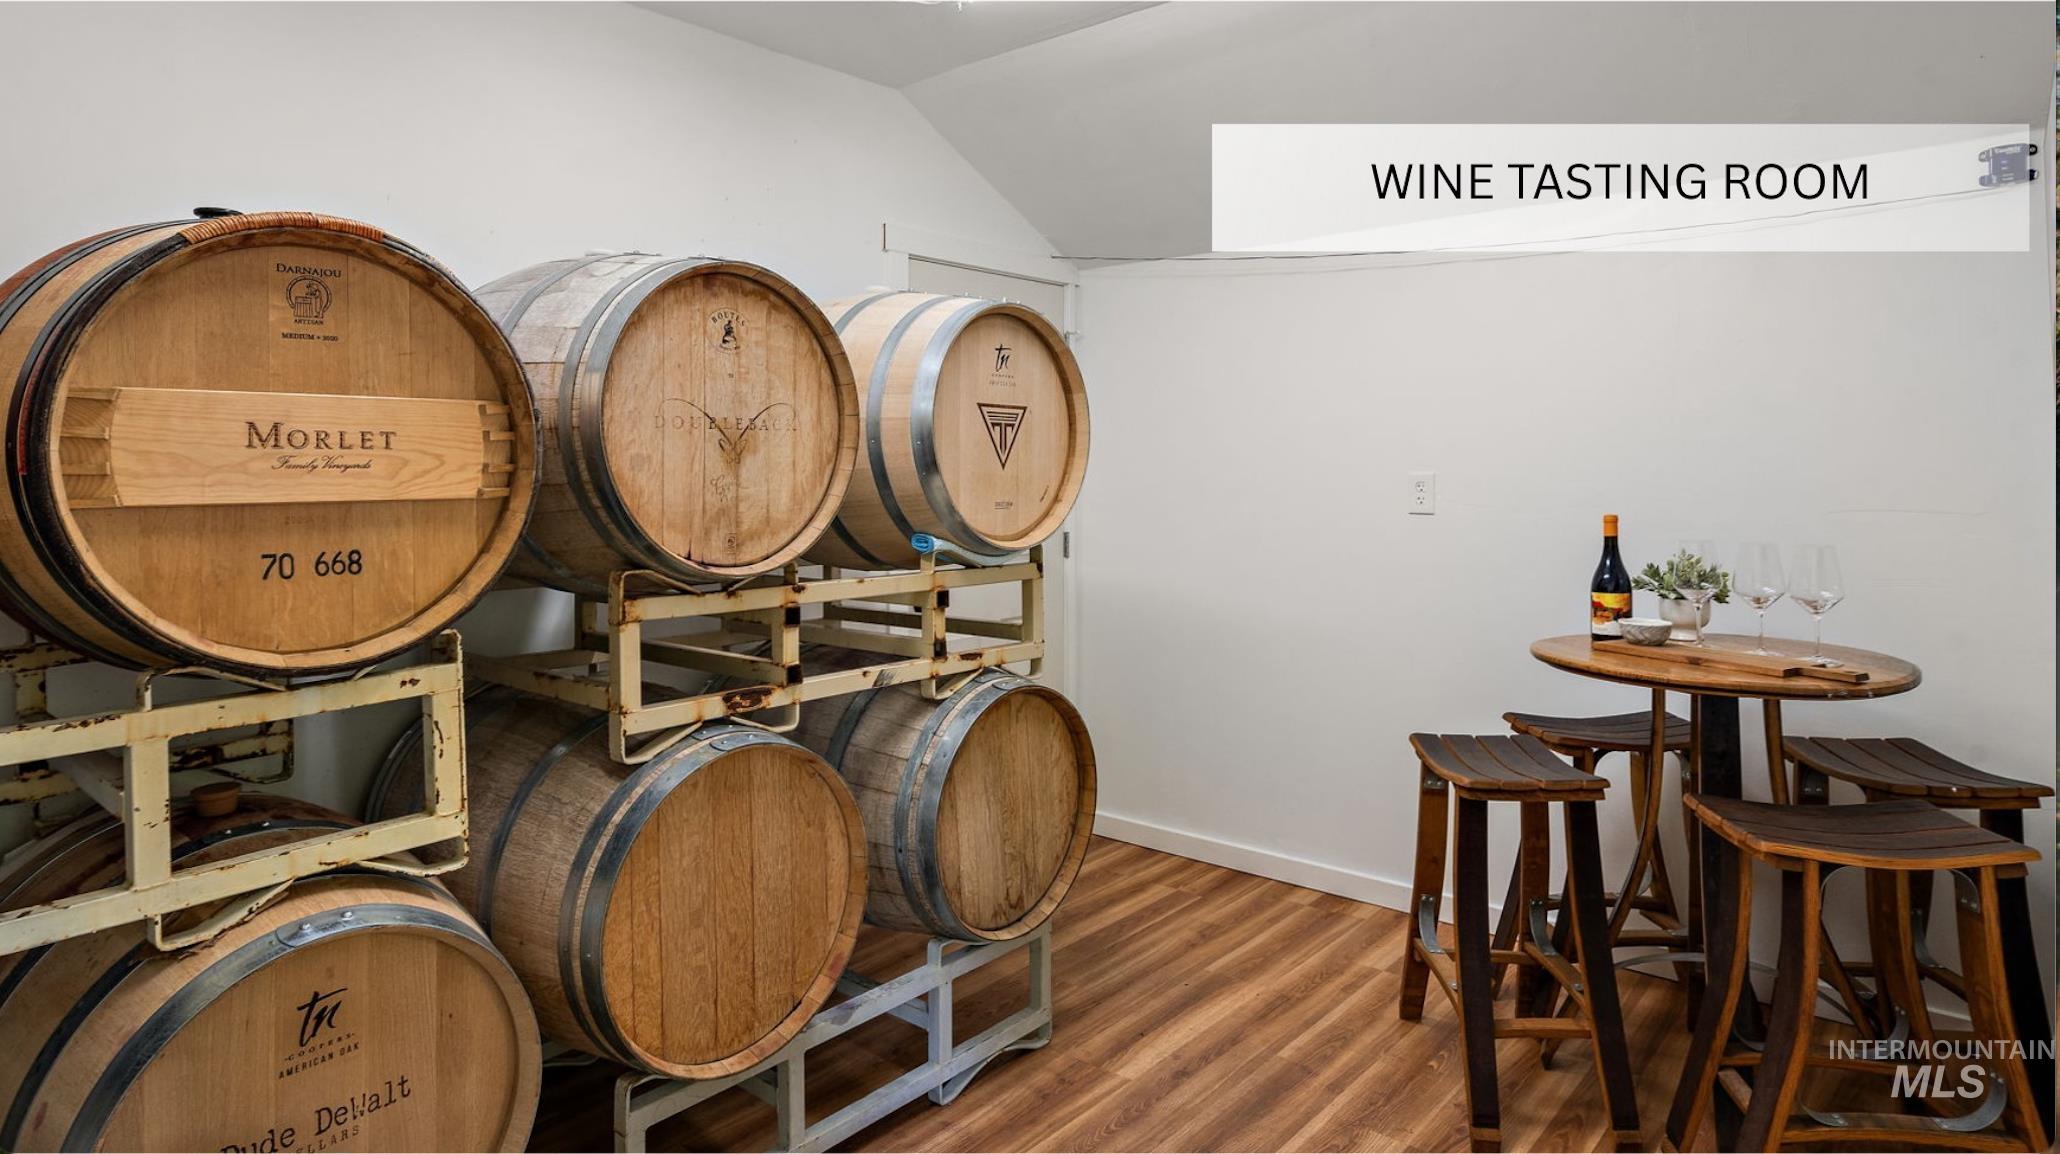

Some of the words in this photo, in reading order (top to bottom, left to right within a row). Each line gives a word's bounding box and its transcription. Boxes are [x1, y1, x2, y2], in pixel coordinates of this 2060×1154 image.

[276, 263, 341, 278] DARNAJOU
[245, 421, 397, 450] MORLET
[271, 454, 319, 474] Family
[321, 454, 373, 474] Vineyards
[261, 552, 295, 580] 70
[314, 549, 362, 577] 668
[278, 1052, 334, 1079] AMERICAN
[339, 1041, 360, 1057] OAK
[314, 1075, 412, 1136] DeWalt
